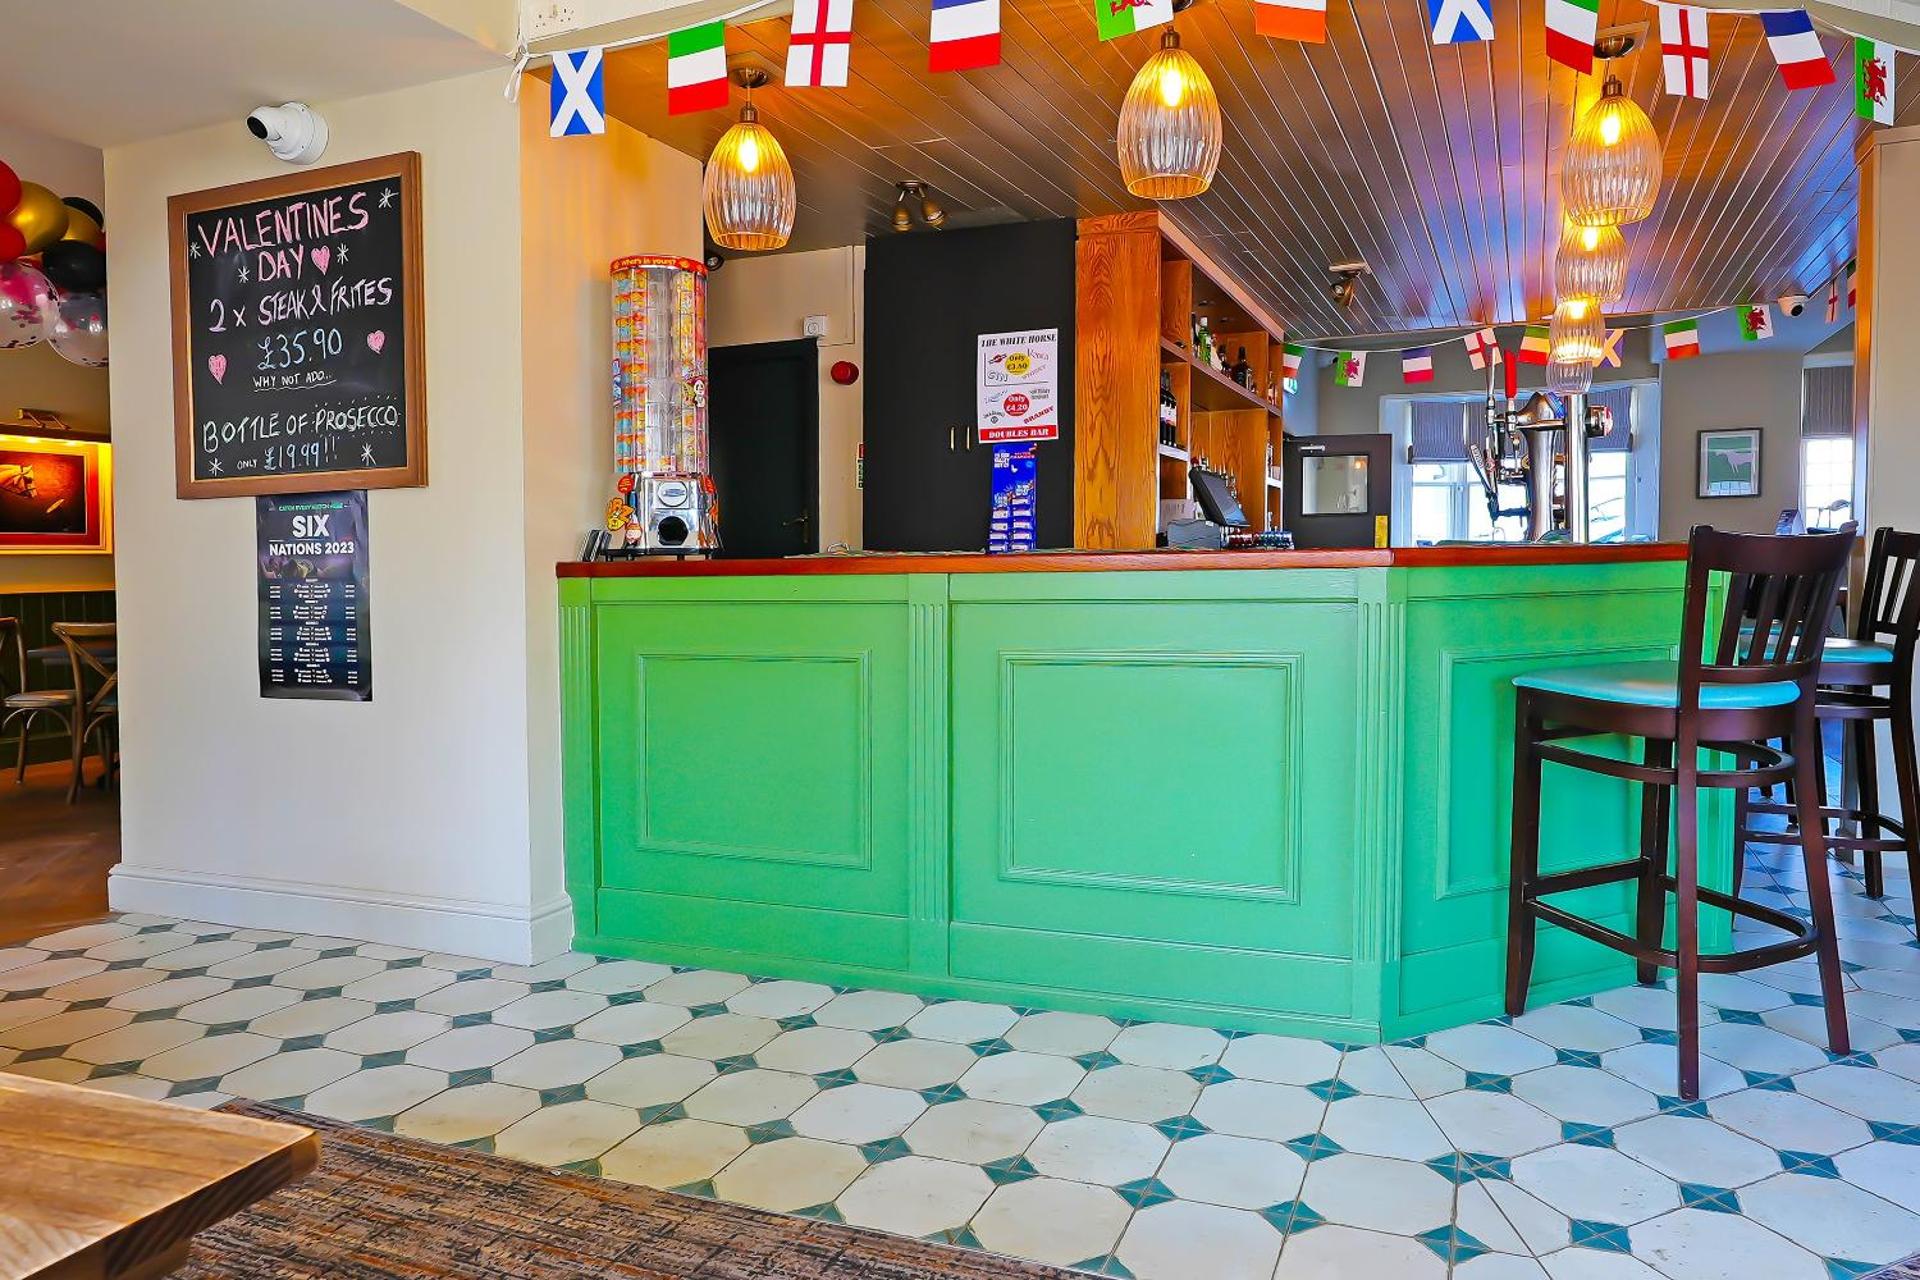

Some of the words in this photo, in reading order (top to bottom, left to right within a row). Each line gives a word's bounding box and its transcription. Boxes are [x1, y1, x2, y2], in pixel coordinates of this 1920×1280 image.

[197, 191, 369, 257] VALENTINES
[257, 243, 304, 282] DAY
[208, 298, 226, 333] 2
[257, 288, 310, 326] STEAK
[329, 275, 394, 316] FRITES
[257, 327, 343, 371] £35.90
[981, 338, 998, 348] THE
[999, 336, 1027, 346] WHITE
[1028, 333, 1057, 344] HORSE
[1009, 354, 1025, 362] Only
[252, 374, 277, 388] WHY
[281, 372, 301, 386] NOT
[1023, 405, 1054, 424] BRANDY
[202, 412, 281, 454] BOTTLE
[286, 412, 309, 436] OF
[314, 404, 399, 434] PROSECCO
[988, 429, 1029, 439] DOUBLES
[1030, 428, 1049, 437] BAR
[236, 458, 258, 470] ONLY
[292, 514, 330, 538] SIX
[269, 543, 322, 556] NATIONS
[324, 541, 355, 554] 2023
